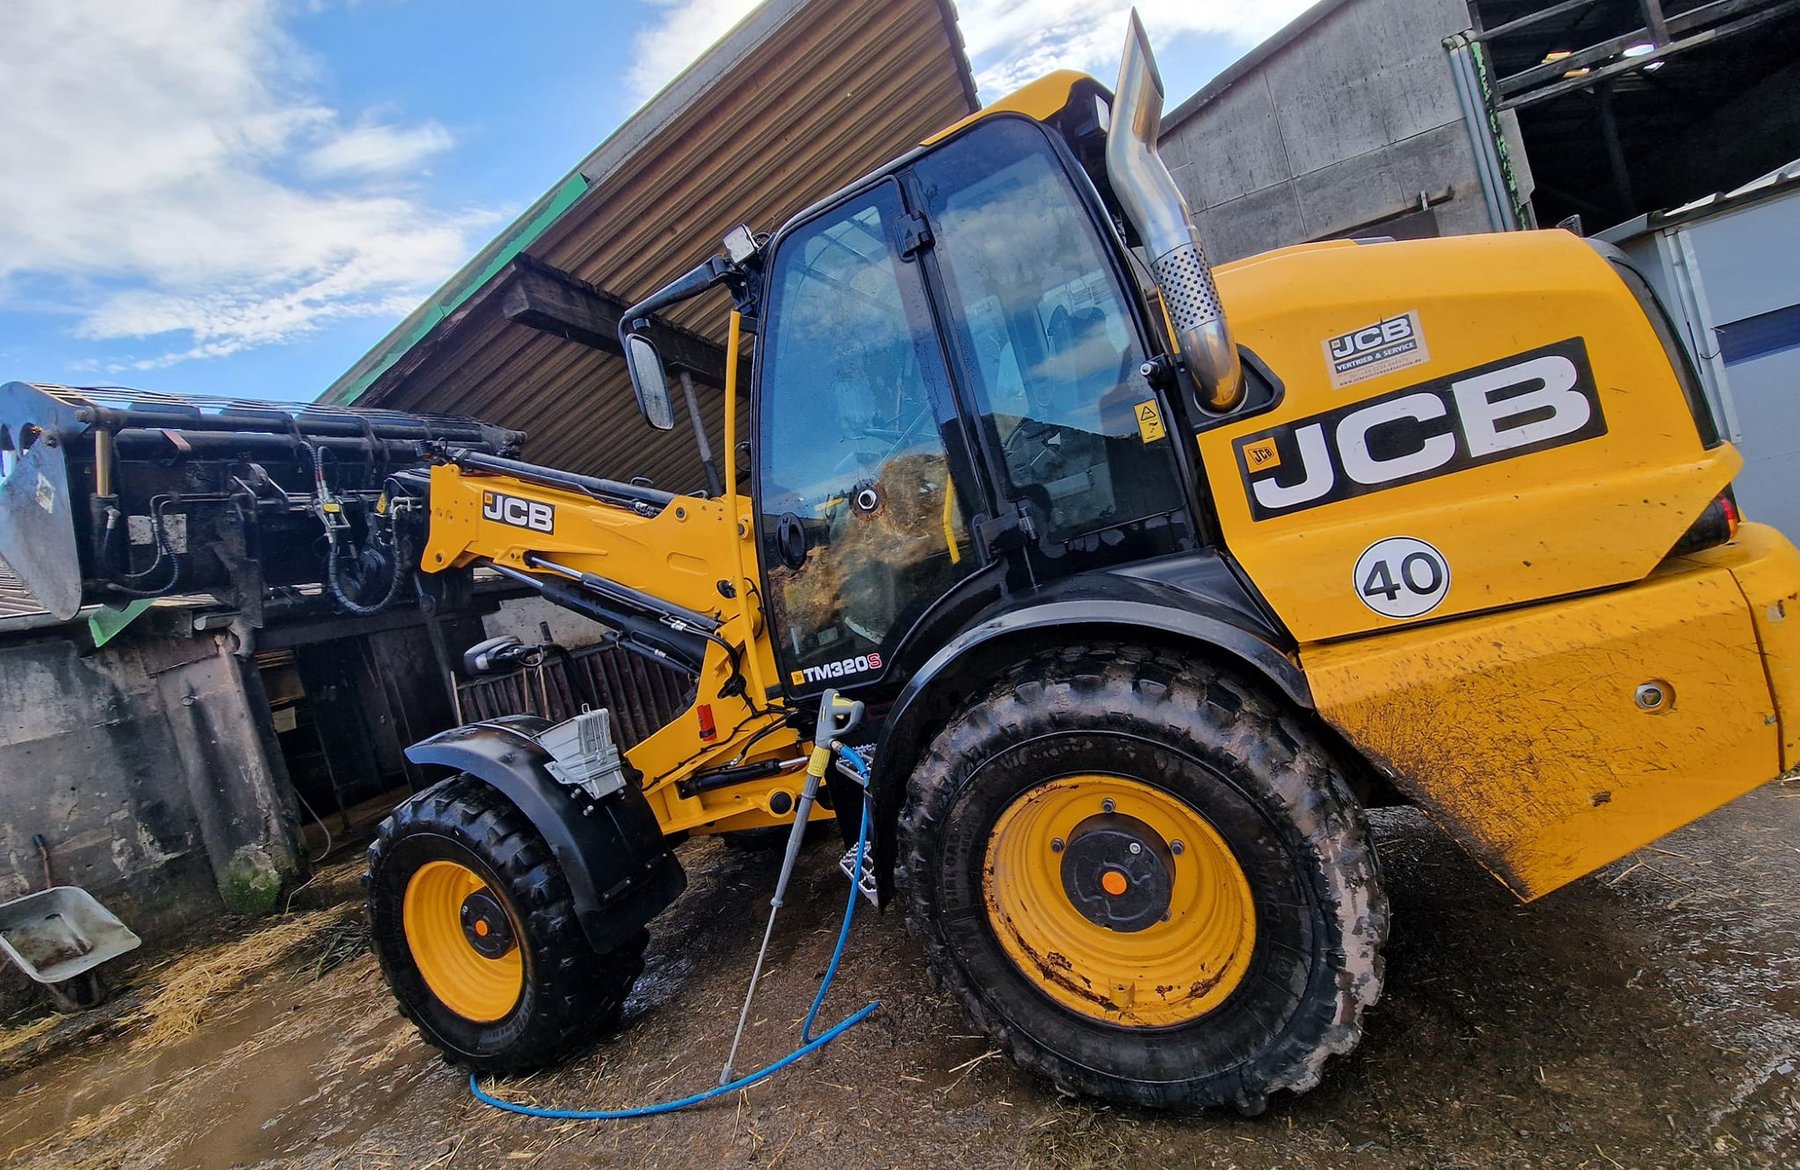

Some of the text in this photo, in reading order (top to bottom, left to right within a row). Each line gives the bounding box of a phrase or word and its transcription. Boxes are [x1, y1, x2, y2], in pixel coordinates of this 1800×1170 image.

[1333, 318, 1411, 358] JCB
[1336, 355, 1374, 372] VERTRIEB
[1383, 341, 1415, 356] SERVICE
[1252, 355, 1591, 509] JCB
[1252, 447, 1272, 462] JCB
[484, 494, 553, 532] JCB
[1362, 551, 1443, 601] 40
[803, 652, 883, 683] TM320S
